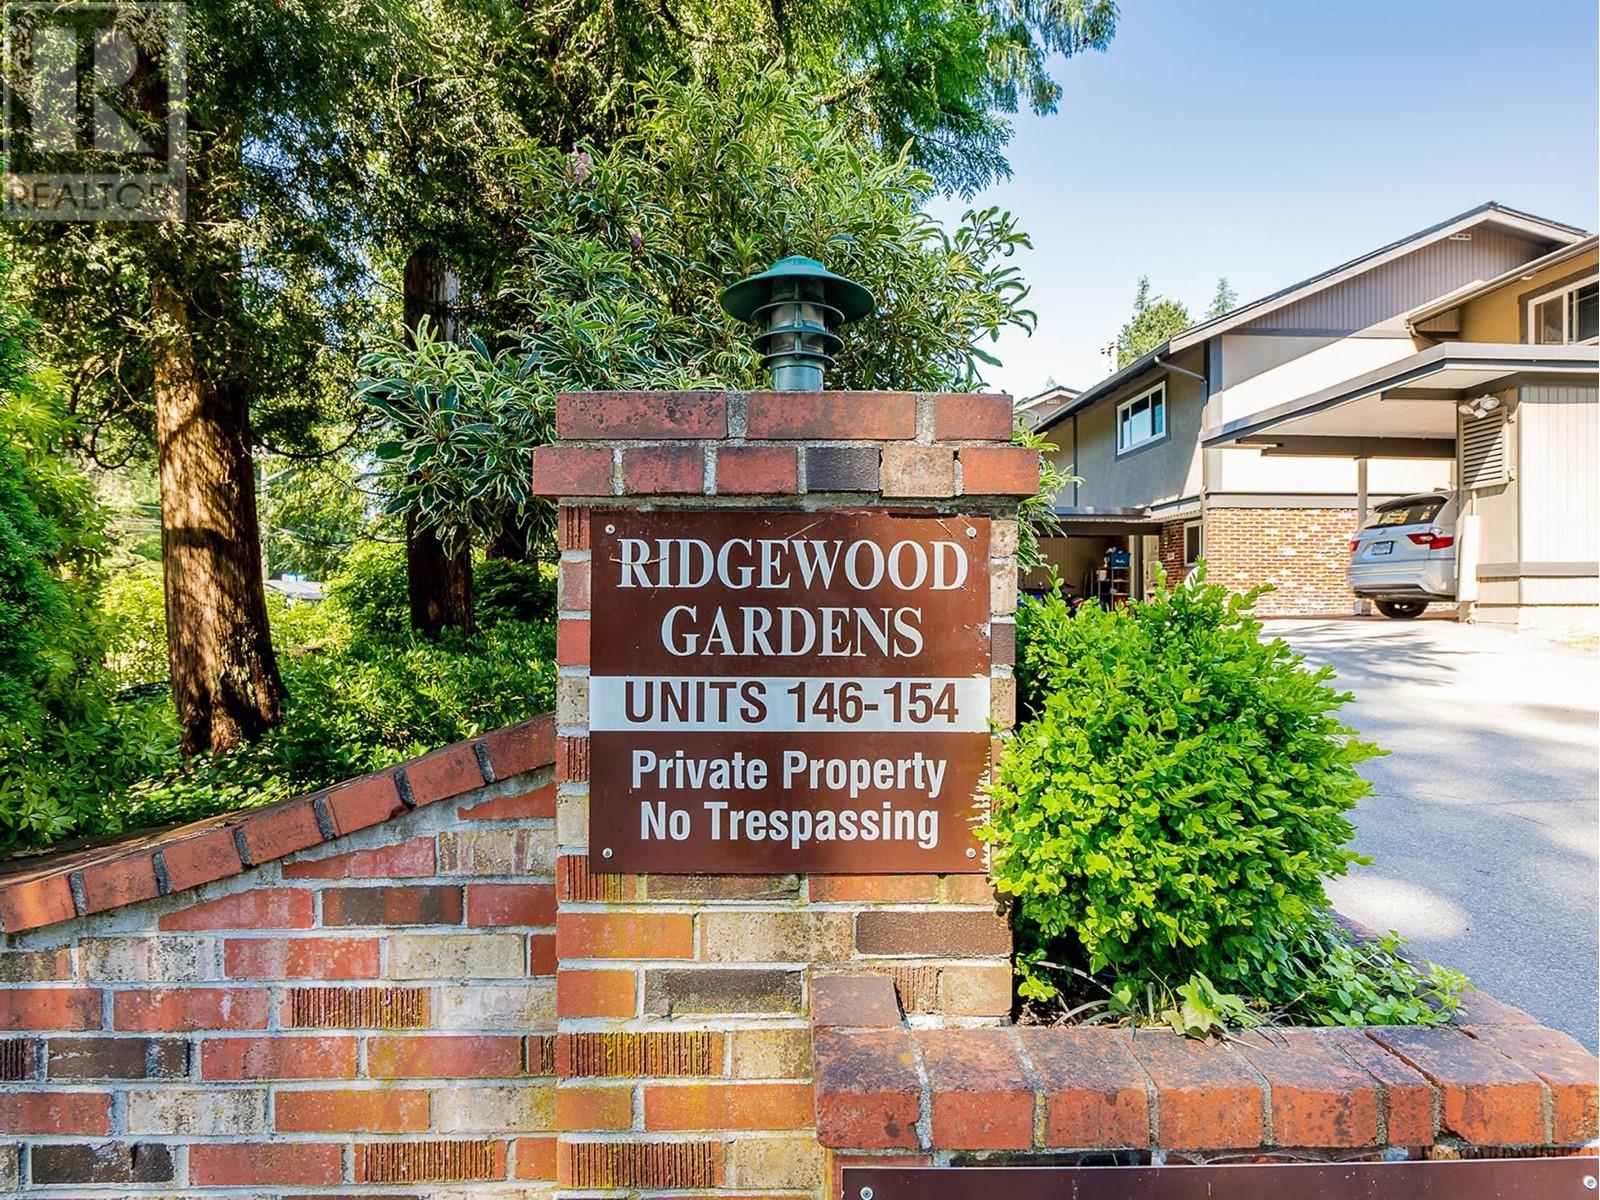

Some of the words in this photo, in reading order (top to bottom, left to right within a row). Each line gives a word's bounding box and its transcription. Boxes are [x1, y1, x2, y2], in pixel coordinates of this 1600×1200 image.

[616, 538, 969, 591] RIDGEWOOD
[661, 605, 924, 658] GARDENS
[625, 680, 768, 724] UNITS
[787, 681, 959, 724] 146-154
[631, 750, 768, 790] Private
[782, 750, 948, 799] Property
[639, 801, 691, 842] No
[704, 801, 939, 850] Trespassing
